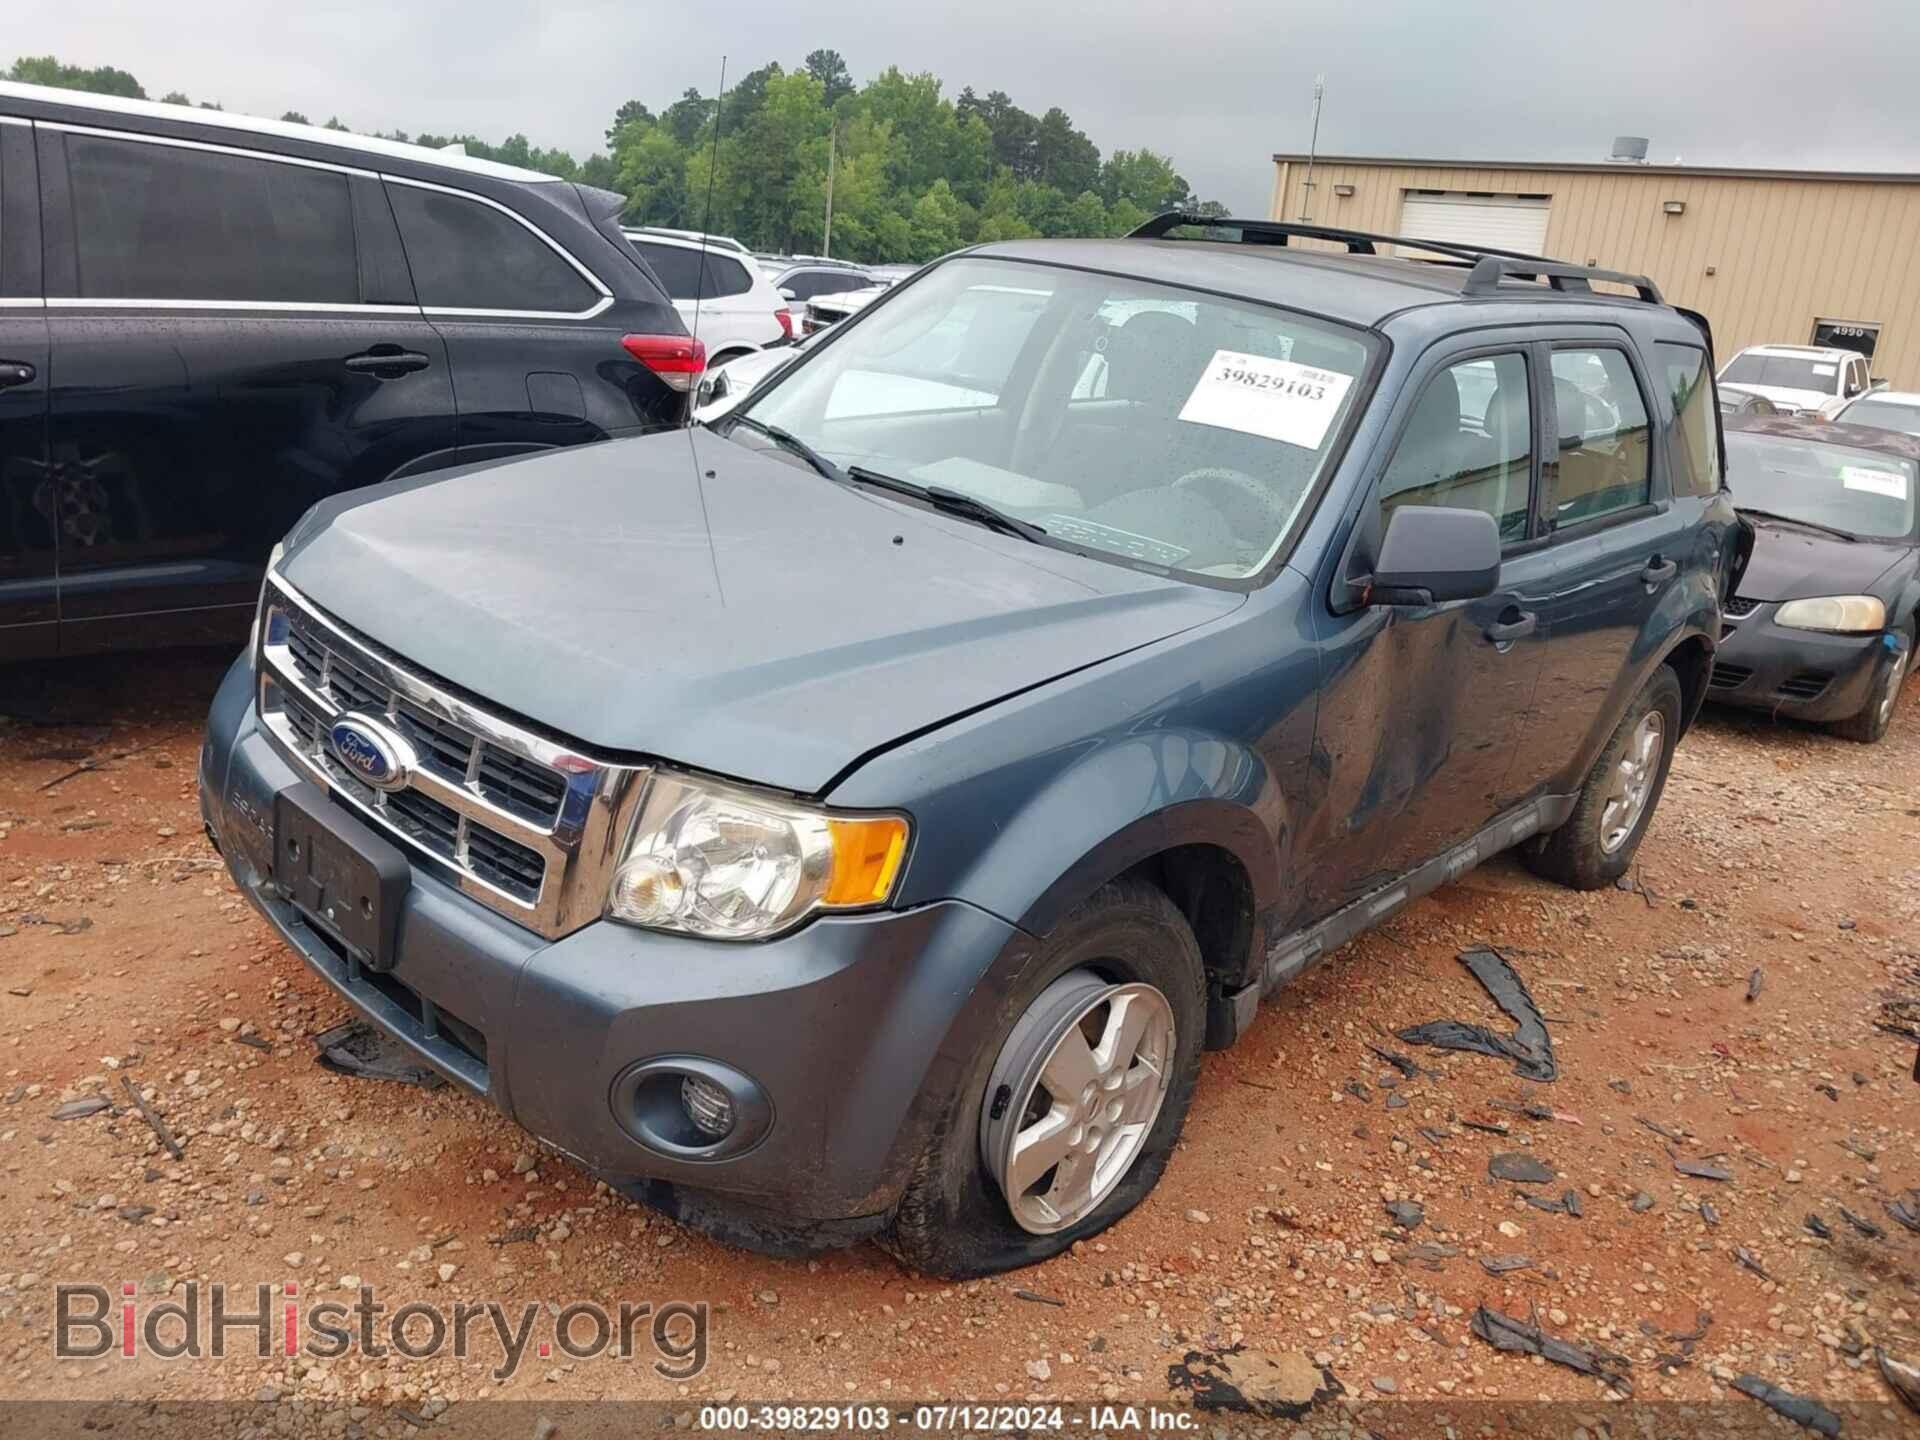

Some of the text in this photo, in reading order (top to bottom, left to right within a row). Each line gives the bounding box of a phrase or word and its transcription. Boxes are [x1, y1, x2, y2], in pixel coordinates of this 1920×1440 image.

[1833, 326, 1864, 337] 4990
[1216, 367, 1326, 401] 39829103
[341, 732, 377, 771] Ford
